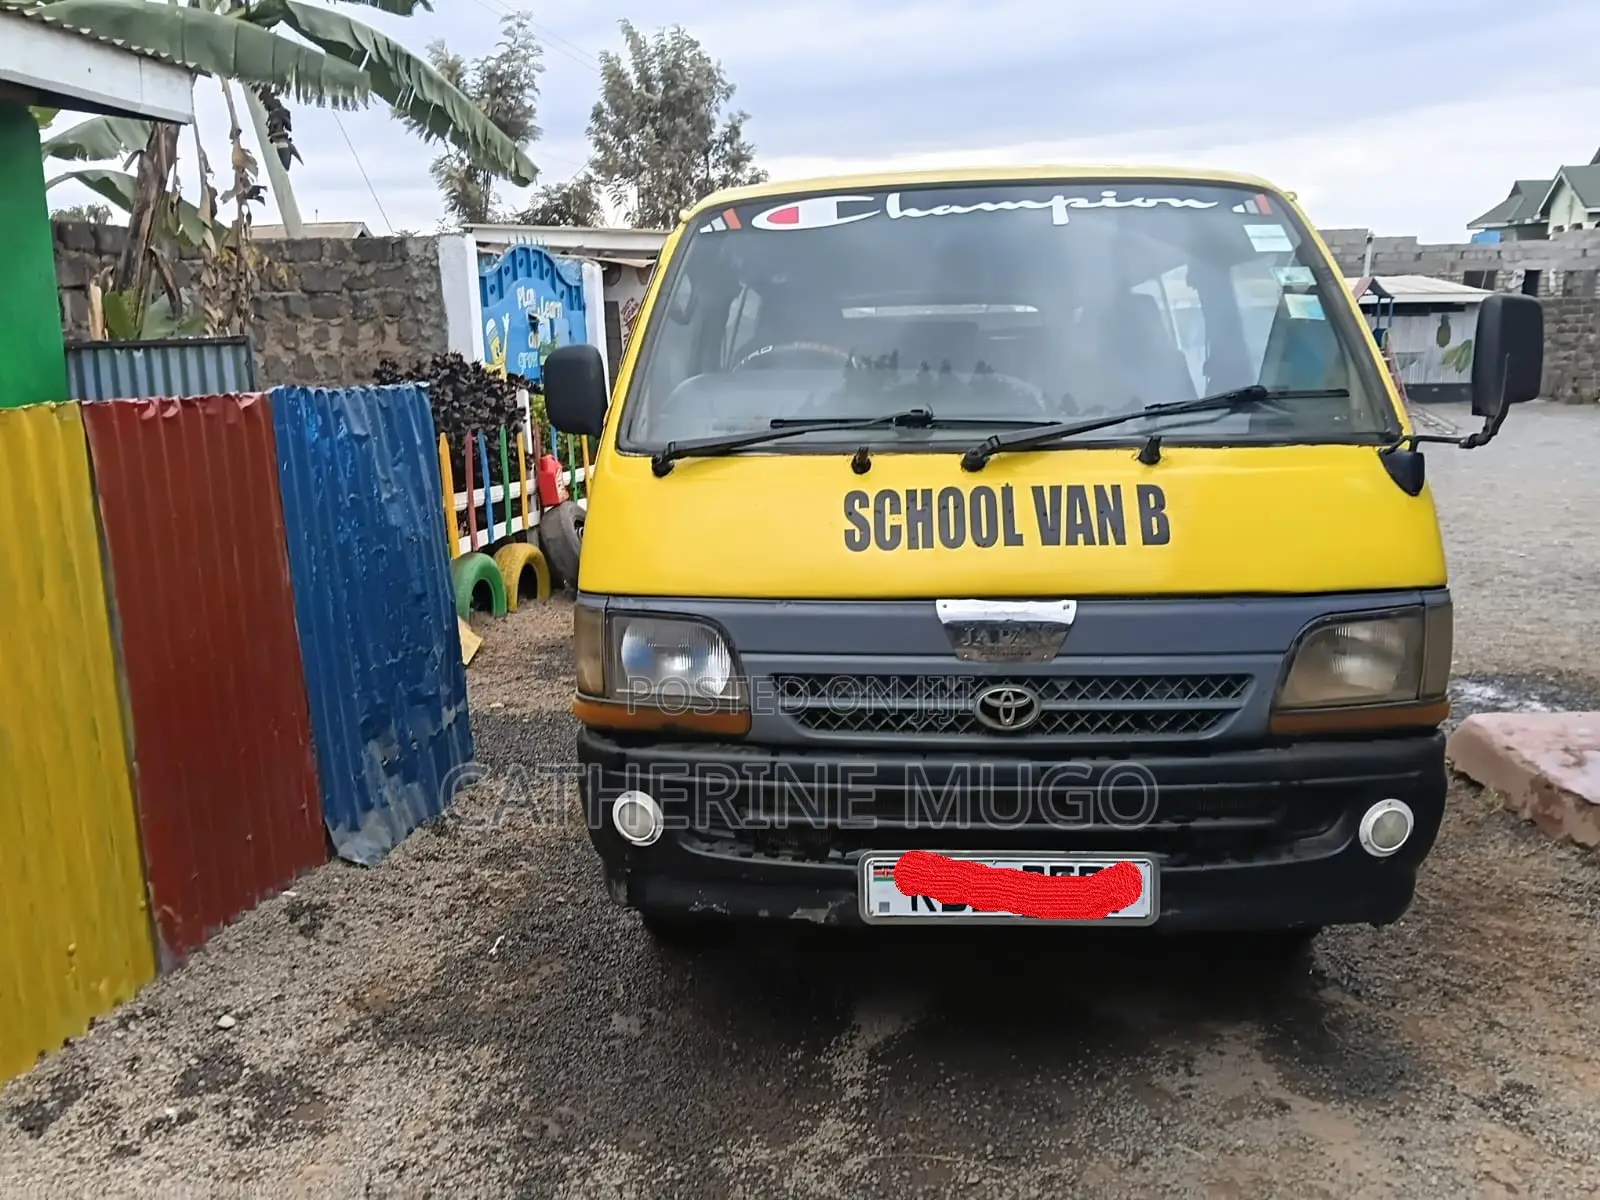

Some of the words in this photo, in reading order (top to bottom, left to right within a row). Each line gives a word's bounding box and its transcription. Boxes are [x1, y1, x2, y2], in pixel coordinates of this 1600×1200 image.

[751, 190, 1219, 231] Champion
[843, 484, 1024, 552] SCHOOL
[1031, 484, 1126, 546] VAN
[1136, 484, 1171, 546] B
